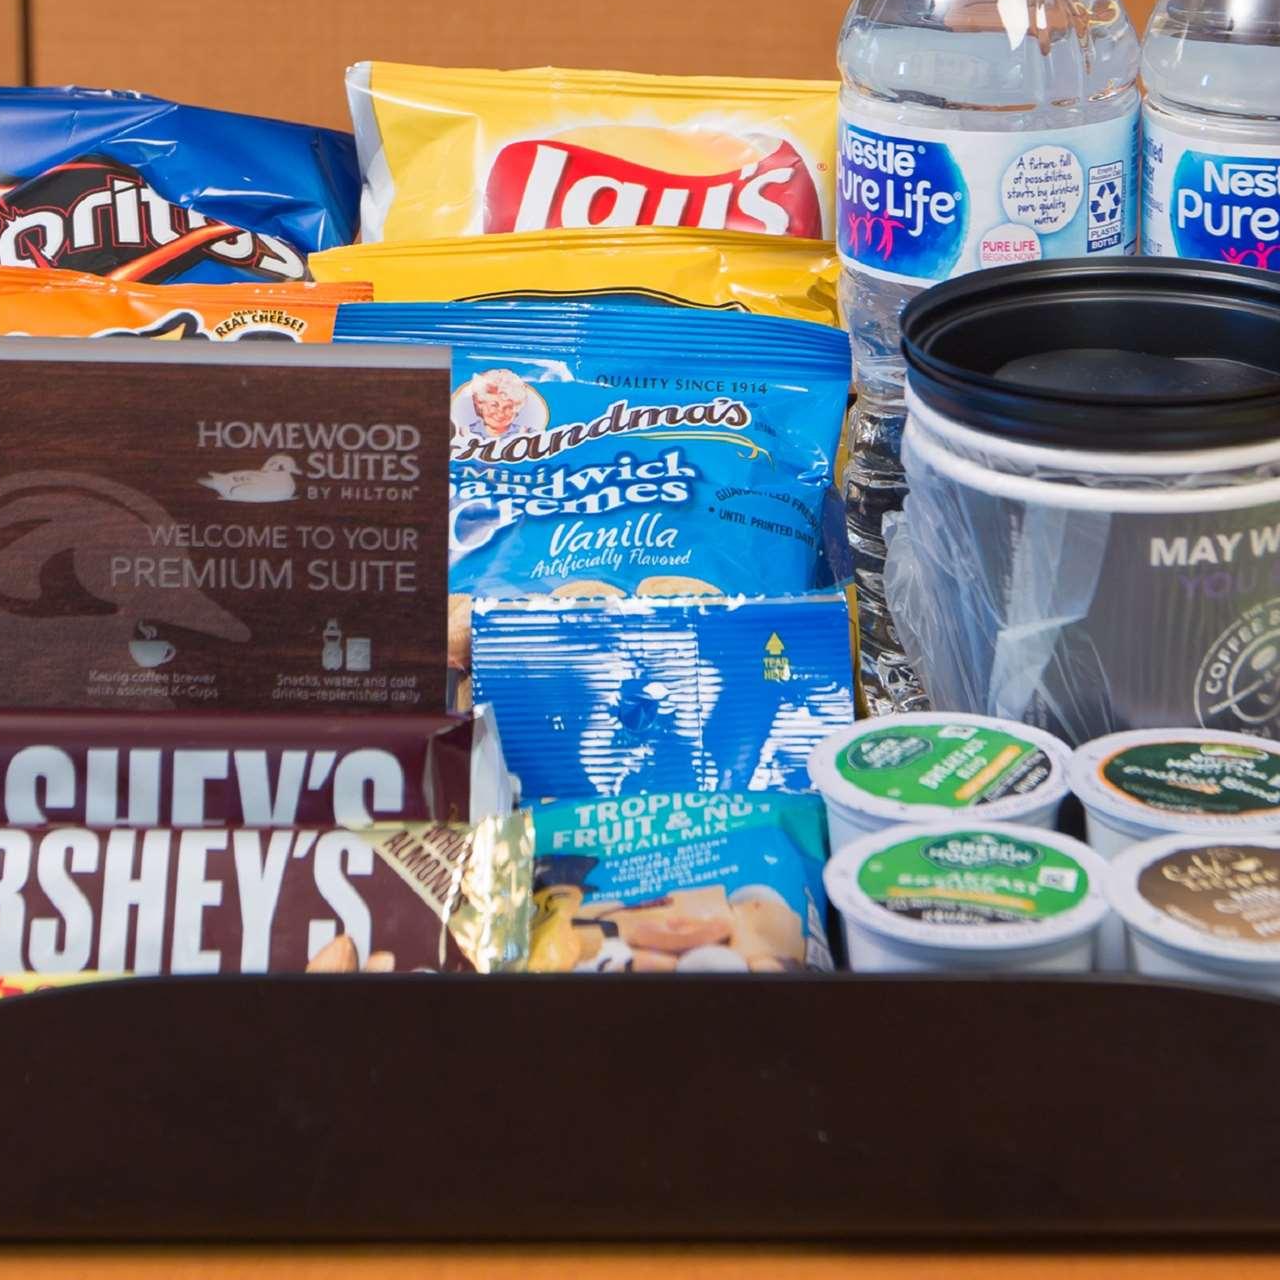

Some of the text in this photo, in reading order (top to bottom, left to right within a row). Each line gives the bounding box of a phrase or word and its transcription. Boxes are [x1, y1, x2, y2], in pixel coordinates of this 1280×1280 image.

[886, 179, 956, 237] Life
[1177, 188, 1280, 241] Pure
[982, 240, 1035, 252] PURE LIFE
[1091, 235, 1119, 250] BOTTLE
[215, 315, 248, 337] REAL
[252, 313, 305, 332] CHEESE!
[596, 374, 768, 395] QUALITY SINCE 1914
[196, 420, 420, 452] HOMEWOOD
[306, 452, 421, 482] SUITES
[461, 466, 547, 484] Mini
[306, 486, 414, 501] BY HILTON
[450, 481, 689, 552] Cremes
[147, 524, 419, 551] WELCOME TO YOUR
[549, 512, 679, 558] Vanilla
[1150, 532, 1243, 567] MAY
[109, 556, 417, 593] PREMIUM SUITE
[530, 548, 692, 579] Artificially Flavored
[553, 816, 655, 849] FRUIT
[664, 811, 693, 831] &
[604, 820, 729, 857] TRAIL MIX
